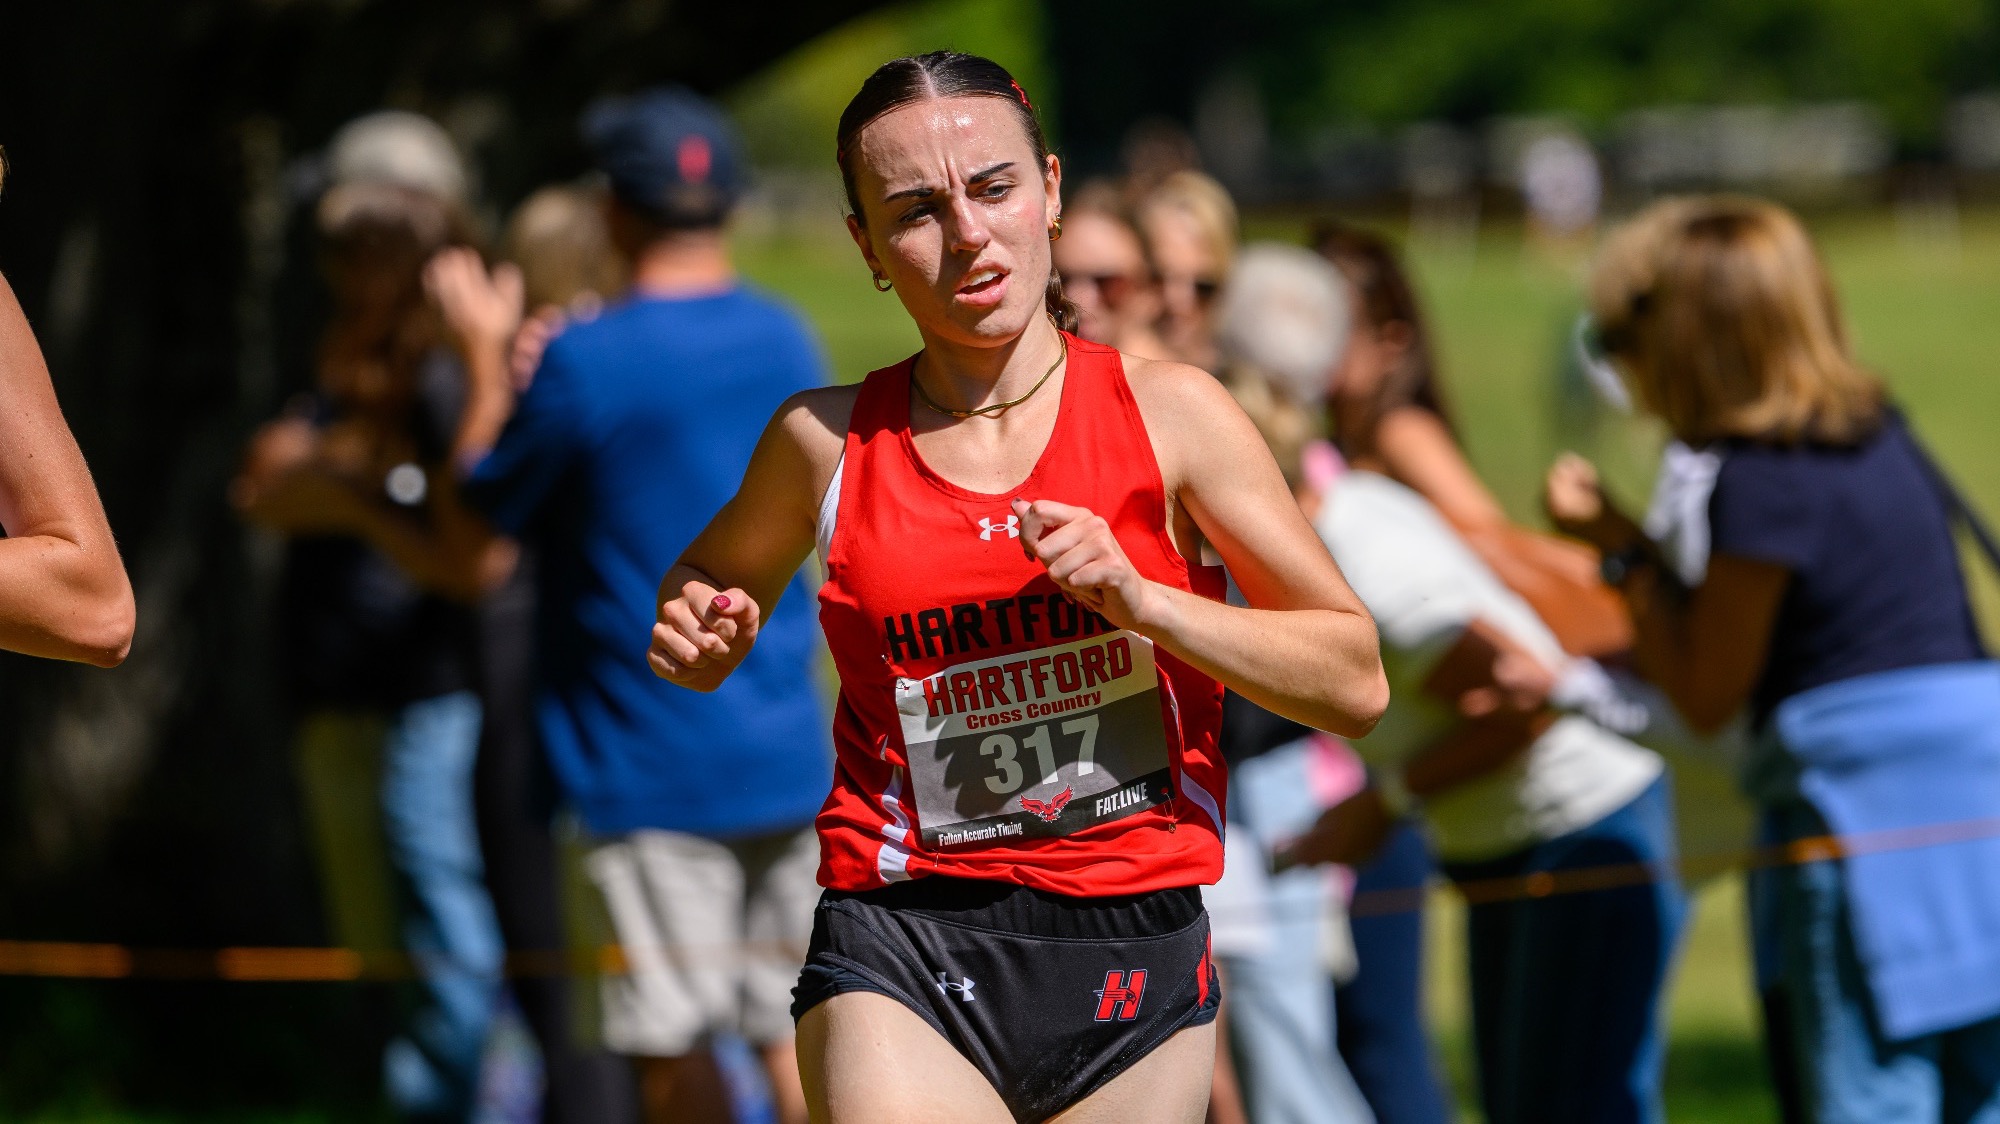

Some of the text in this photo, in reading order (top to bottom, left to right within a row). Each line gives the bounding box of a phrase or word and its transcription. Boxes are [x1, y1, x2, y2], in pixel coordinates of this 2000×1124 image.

[922, 637, 1133, 718] HARTFORD
[966, 690, 1102, 730] Cross Country
[979, 713, 1100, 794] 317
[1096, 782, 1149, 817] FAT.LIVE
[938, 821, 1023, 847] Fulton Accurate Timing
[1094, 969, 1148, 1022] H
